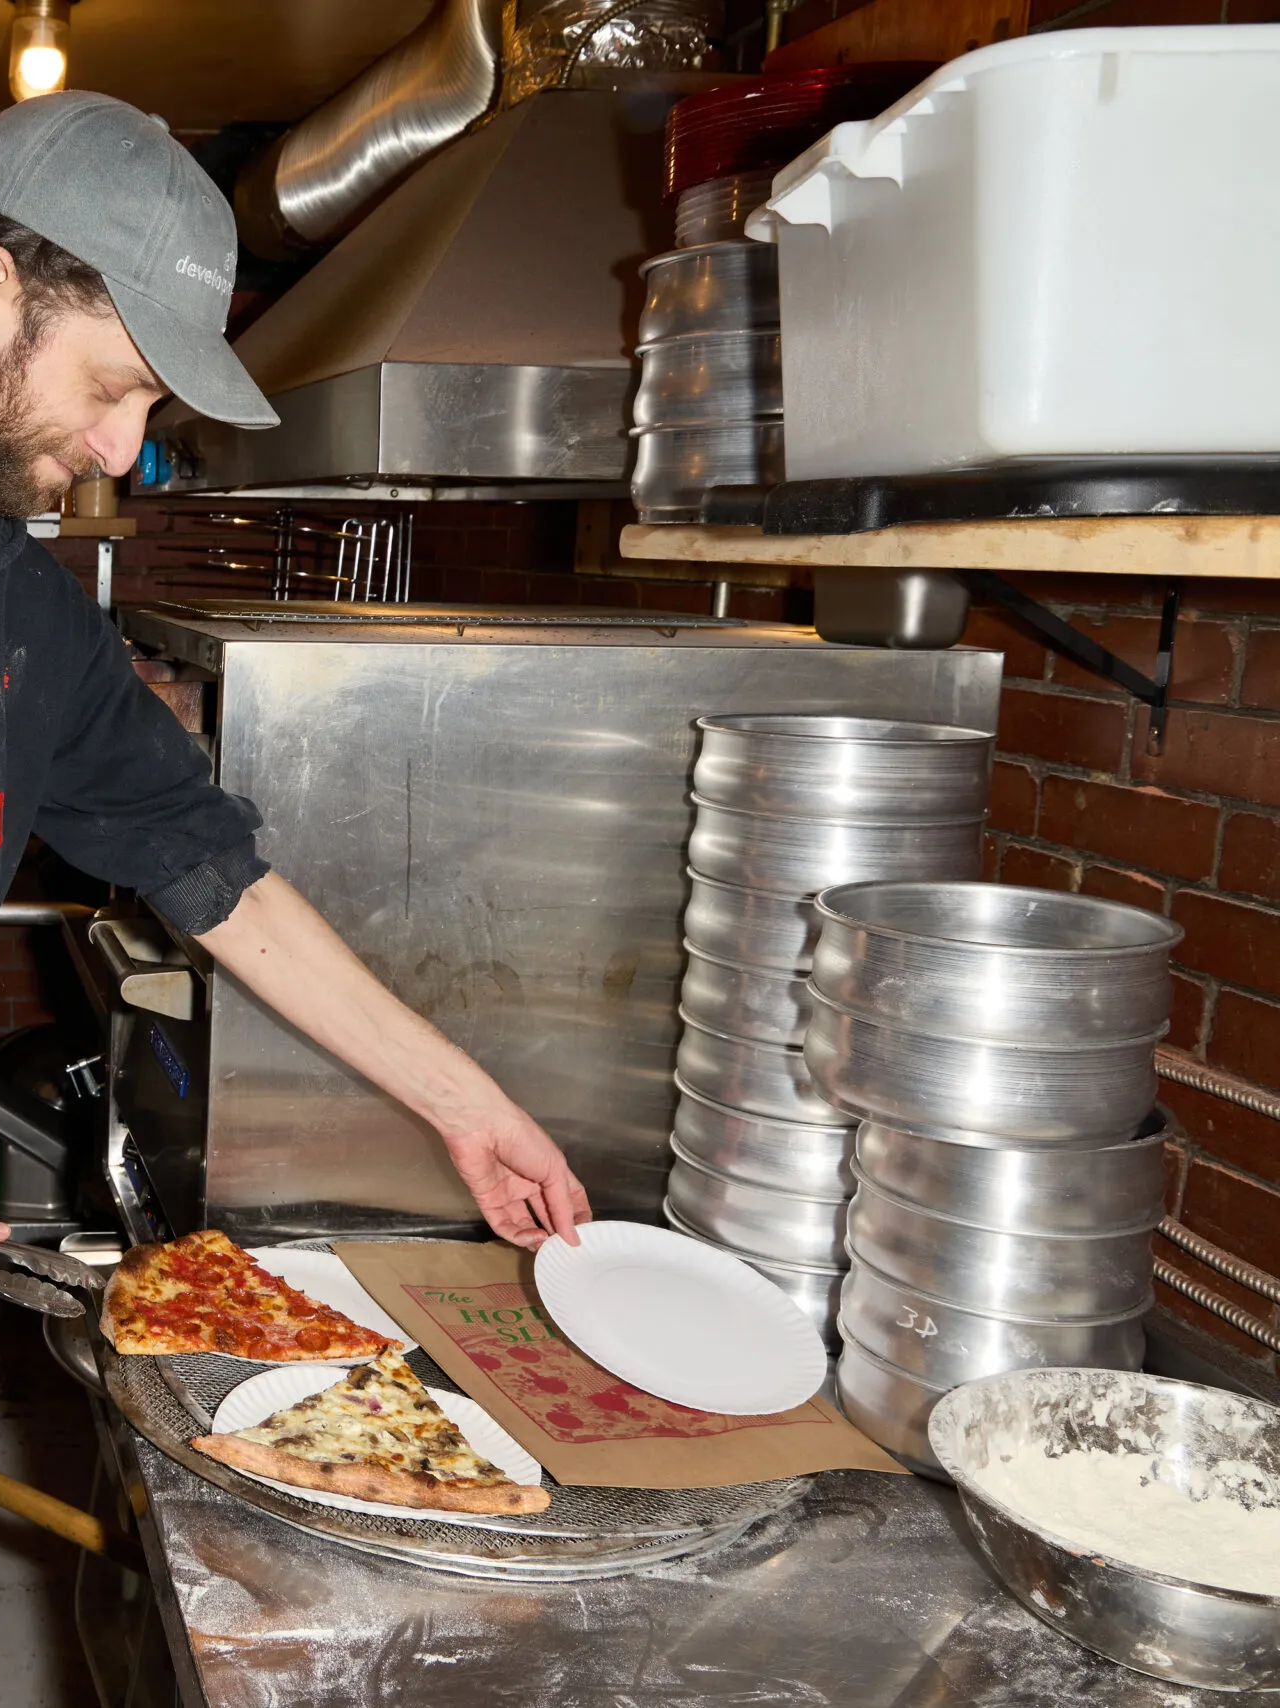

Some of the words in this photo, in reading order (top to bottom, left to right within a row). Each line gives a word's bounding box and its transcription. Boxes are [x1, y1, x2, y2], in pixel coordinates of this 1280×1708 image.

[424, 1290, 473, 1303] The
[458, 1304, 545, 1324] HOT
[496, 1323, 558, 1342] SLI
